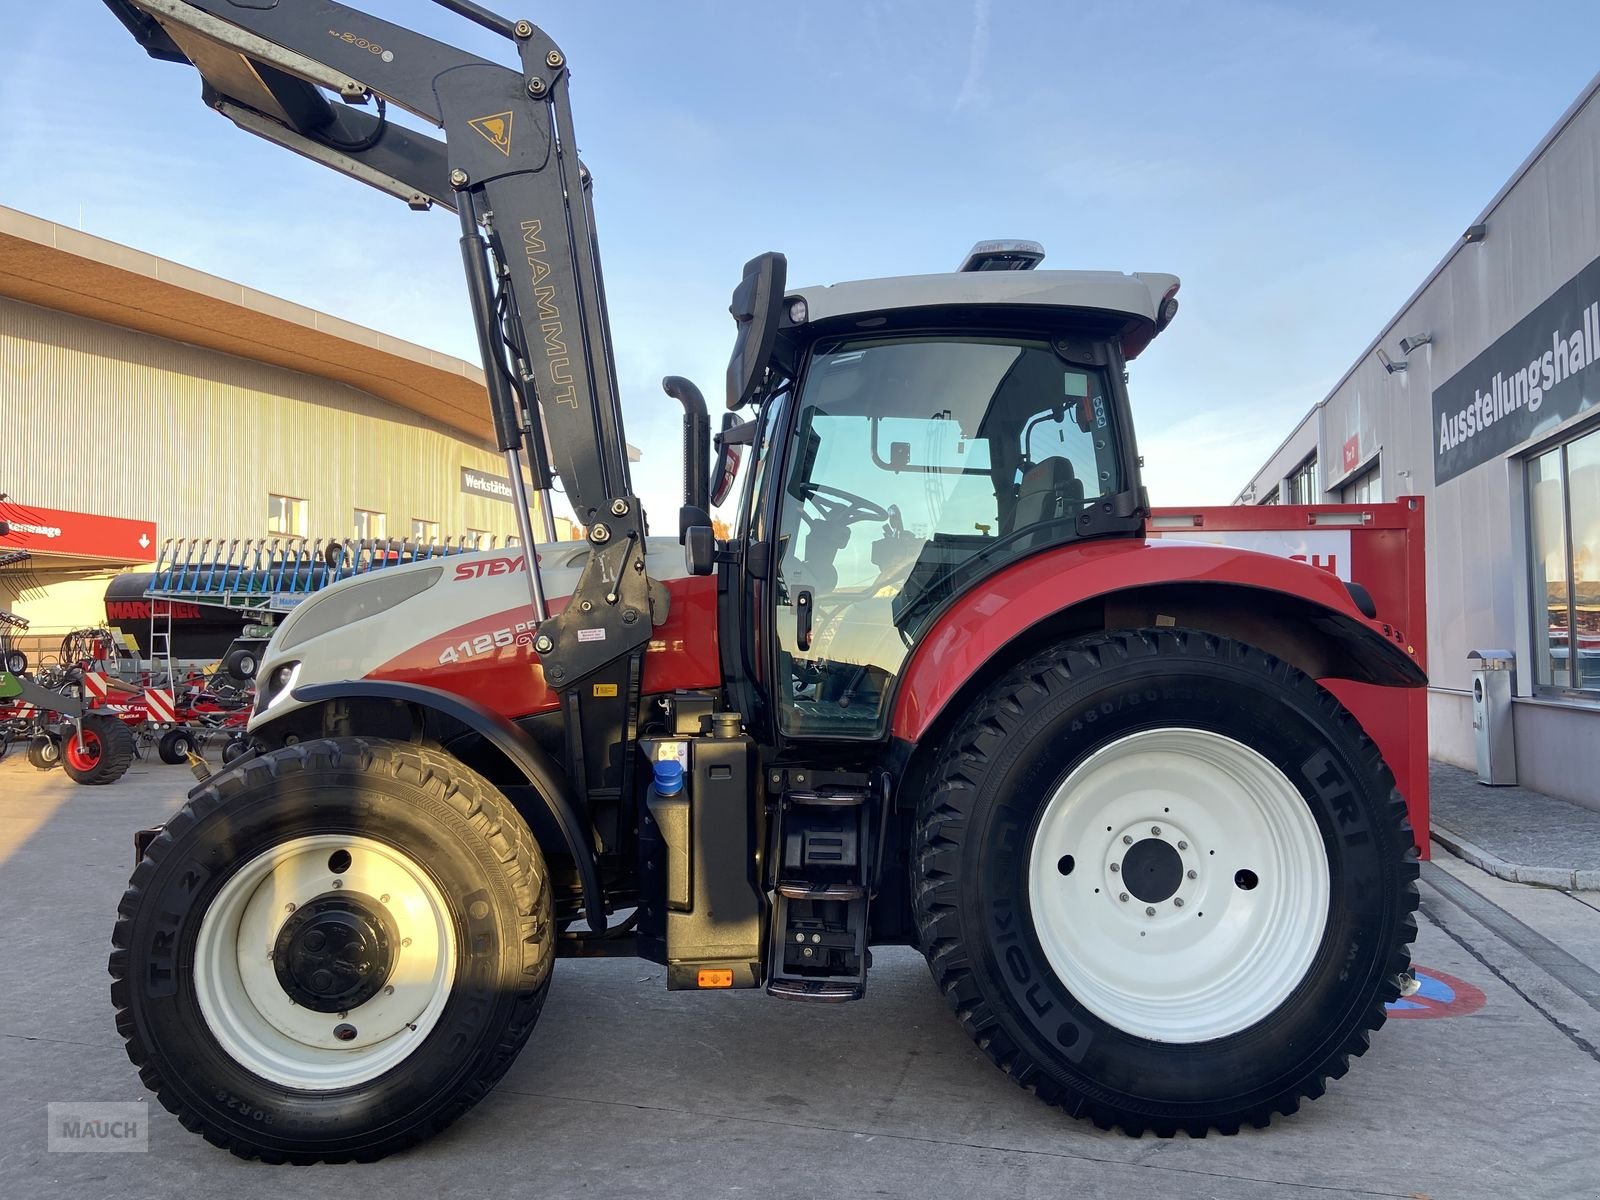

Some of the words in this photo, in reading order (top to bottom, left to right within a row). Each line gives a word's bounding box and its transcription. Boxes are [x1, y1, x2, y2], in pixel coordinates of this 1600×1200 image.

[340, 32, 383, 54] 200
[520, 219, 578, 409] MAMMUT
[1439, 301, 1600, 454] Ausstellungshall
[438, 628, 514, 665] 4125
